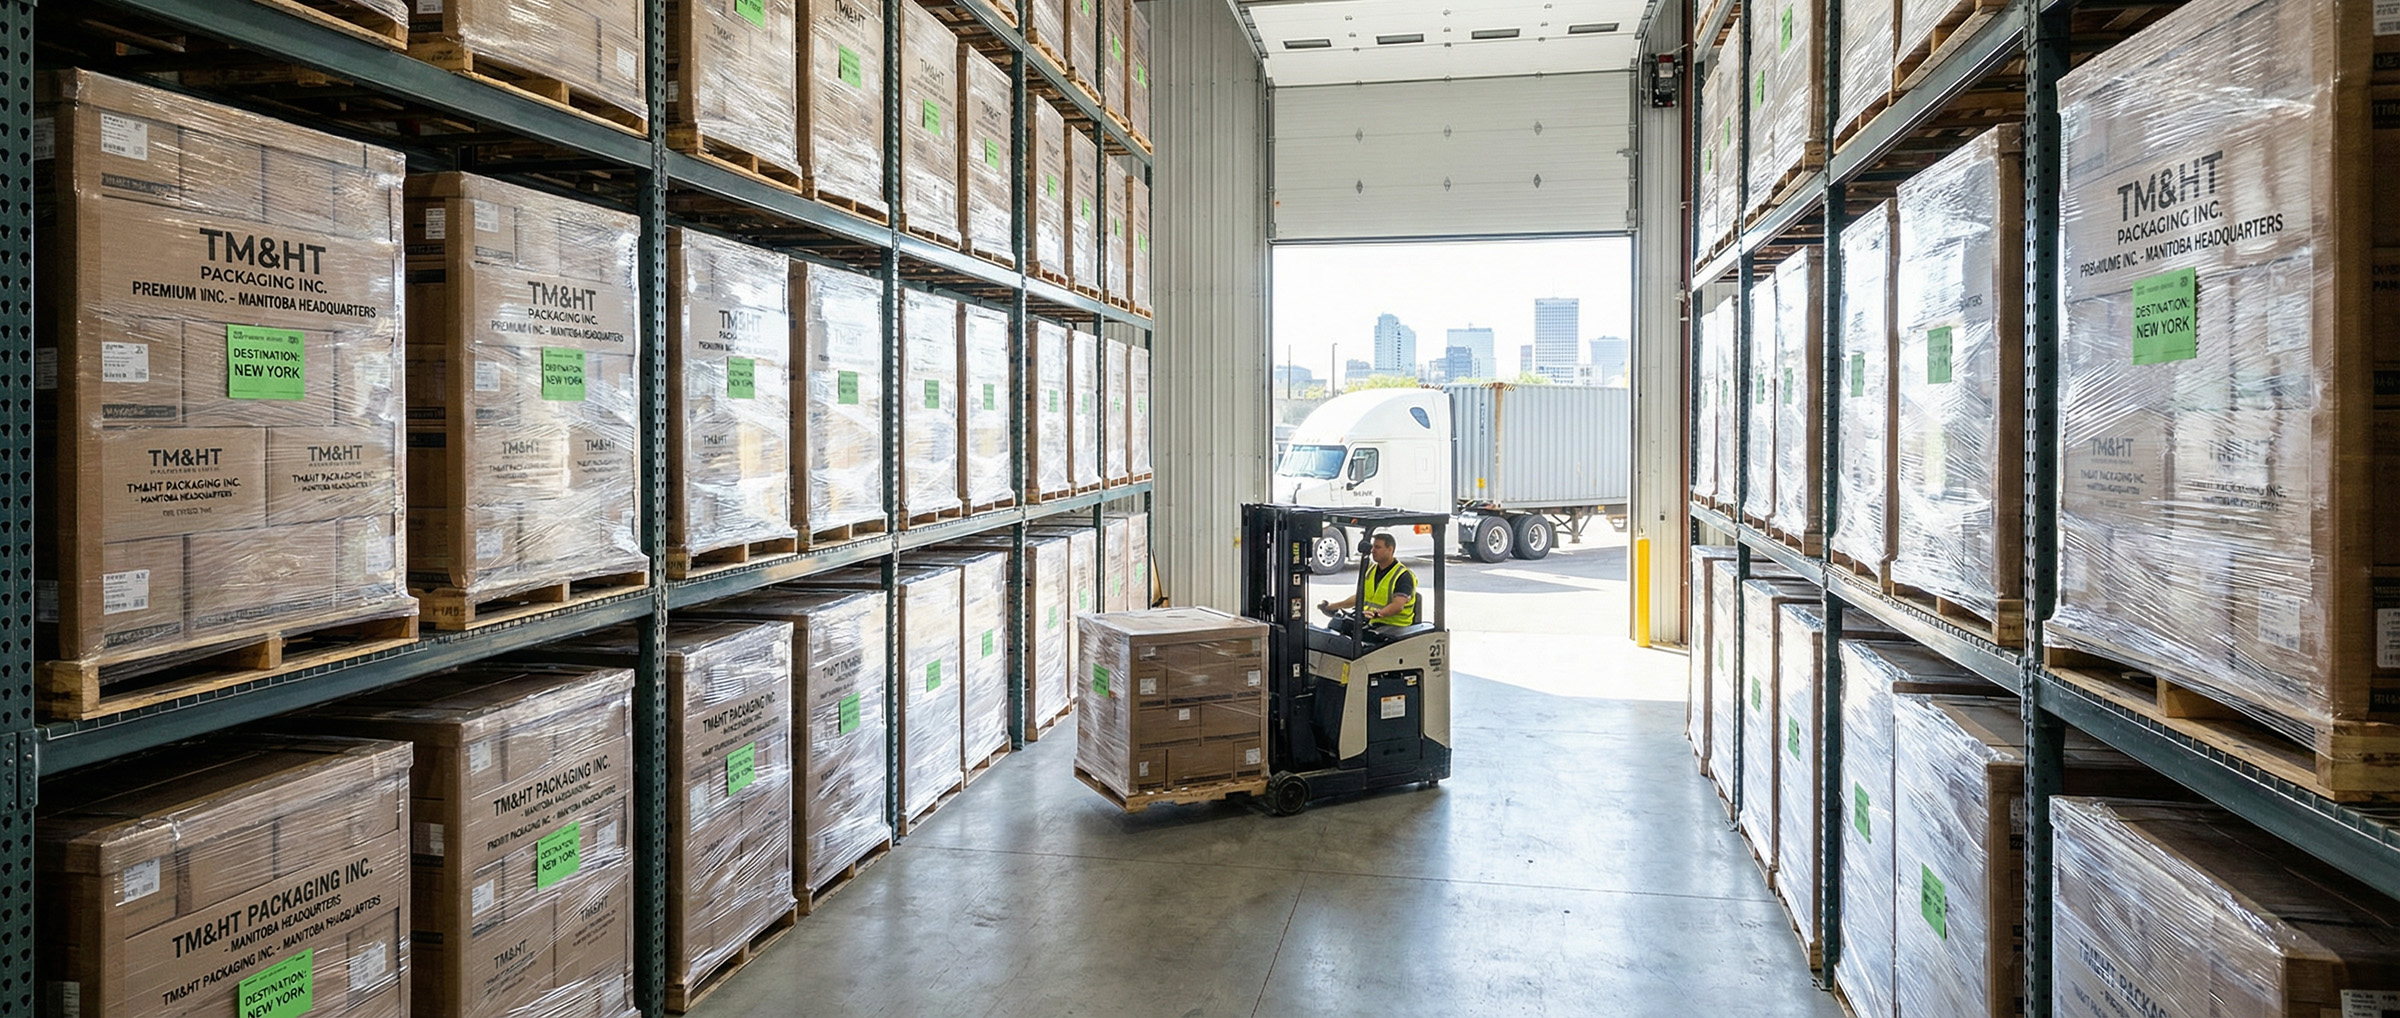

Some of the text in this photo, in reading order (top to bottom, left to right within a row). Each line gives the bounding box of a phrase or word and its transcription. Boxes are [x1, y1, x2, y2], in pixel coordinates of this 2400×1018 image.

[2117, 150, 2224, 222] TM&HT
[2117, 200, 2224, 246] PACKAGING INC.
[2145, 235, 2193, 265] MANITOBA
[2194, 213, 2284, 251] HEADQUARTERS
[199, 227, 326, 275] TM&HT
[200, 265, 328, 295] PACKAGING INC.
[527, 280, 597, 312] TM&HT
[132, 280, 197, 301] PREMIUM
[238, 291, 297, 311] MANITOBA
[298, 298, 377, 319] HEADQUARTERS
[2135, 296, 2191, 319] DESTINATION:
[2136, 316, 2191, 339] NEW YORK
[233, 348, 301, 363] DESTINATION:
[234, 364, 301, 380] NEW YORK
[148, 448, 223, 467] TM&HT
[307, 444, 363, 462] TM&HT
[166, 478, 222, 492] PACKAGING
[493, 786, 533, 817] TM&HT
[536, 762, 592, 799] PACKAGING
[592, 754, 611, 774] INC.
[172, 857, 374, 959] TM&HT PACKAGING INC.
[230, 920, 280, 954] MANITOBA
[162, 979, 201, 1006] TM&HT
[203, 952, 257, 988] PACKAGING
[282, 920, 325, 951] MANITOBA
[244, 969, 308, 1008] DESTINATION:
[247, 983, 306, 1018] NEW YORK
